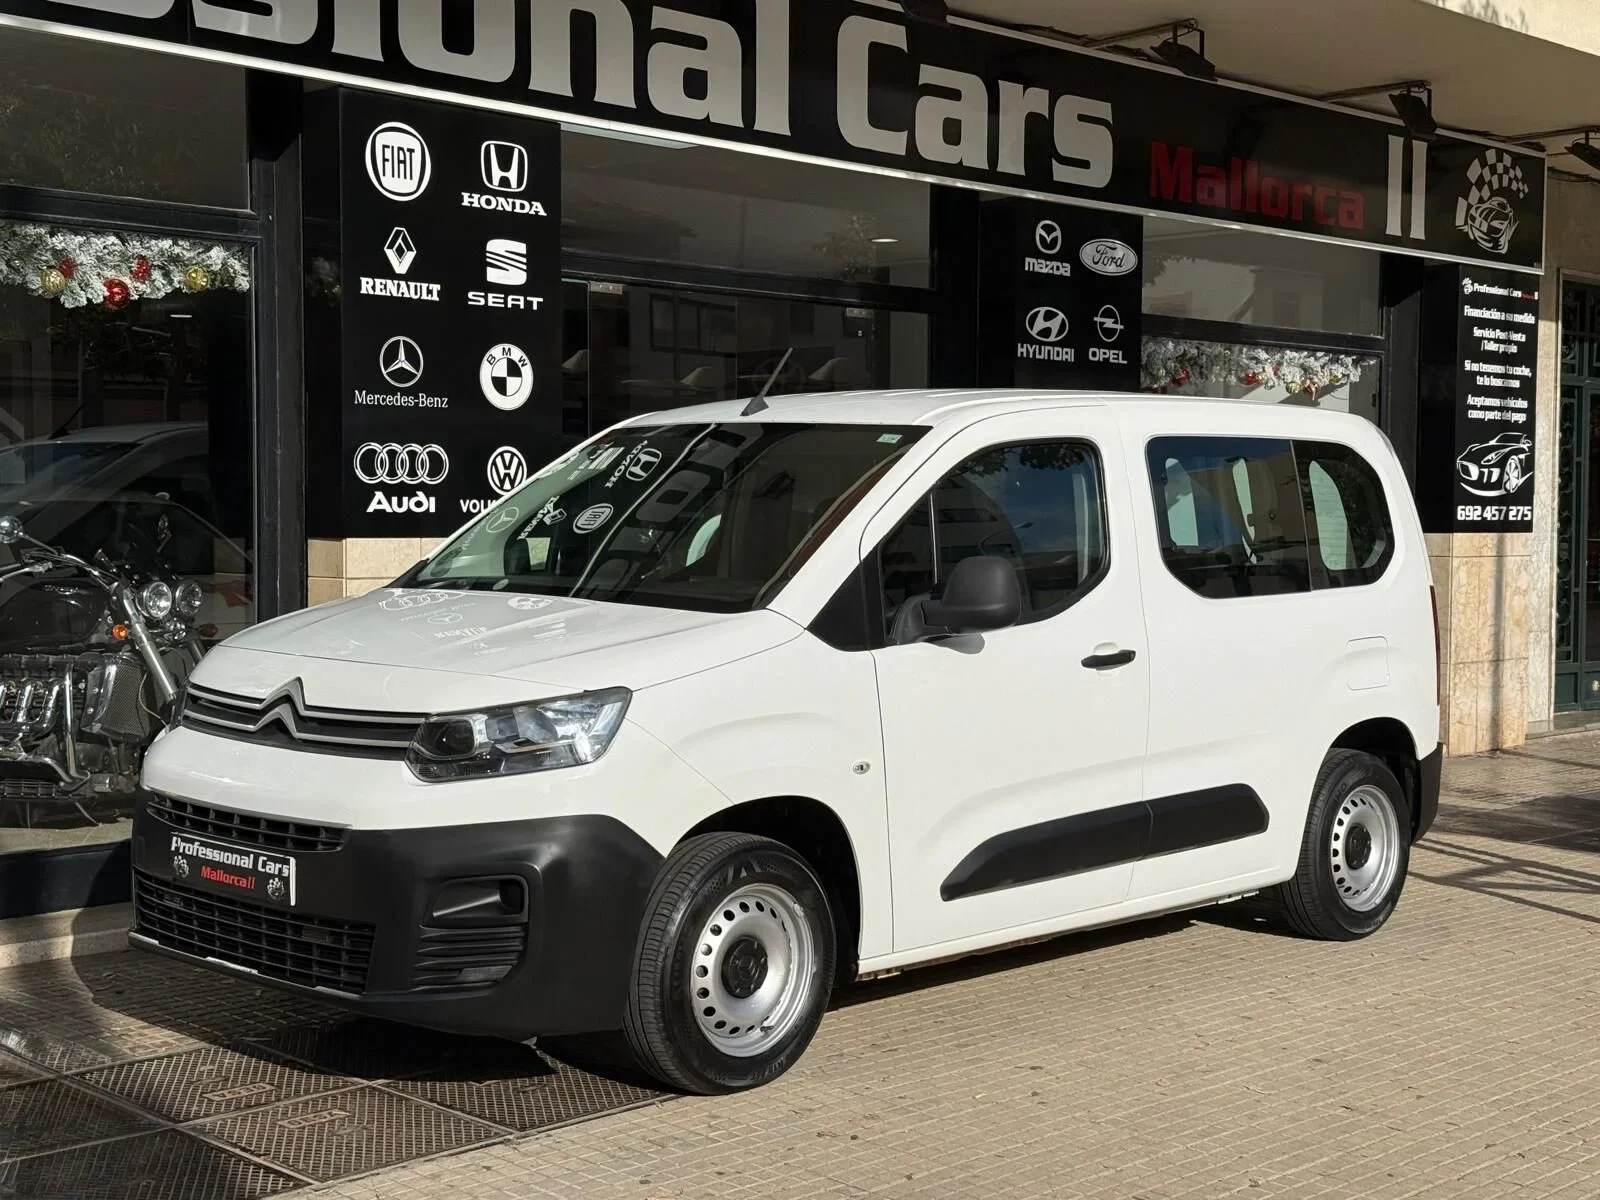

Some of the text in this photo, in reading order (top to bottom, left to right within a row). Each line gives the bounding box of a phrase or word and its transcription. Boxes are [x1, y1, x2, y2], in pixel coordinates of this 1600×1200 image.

[837, 15, 1114, 188] Cars
[1151, 141, 1365, 229] Mallorca
[382, 144, 415, 181] FIAT
[461, 192, 547, 216] HONDA
[1092, 243, 1126, 268] Ford
[360, 277, 440, 301] RENAULT
[1473, 283, 1509, 296] Professional
[467, 291, 544, 310] SEAT
[1513, 312, 1535, 324] medida
[1473, 326, 1495, 339] Servicio
[486, 346, 528, 368] BMW
[1017, 343, 1074, 362] HYUNDAI
[1088, 347, 1128, 364] OPEL
[354, 389, 449, 408] Mercedes-Benz
[366, 491, 435, 513] Audi
[1457, 505, 1532, 520] 692 457 275
[171, 836, 290, 877] Professional Cars
